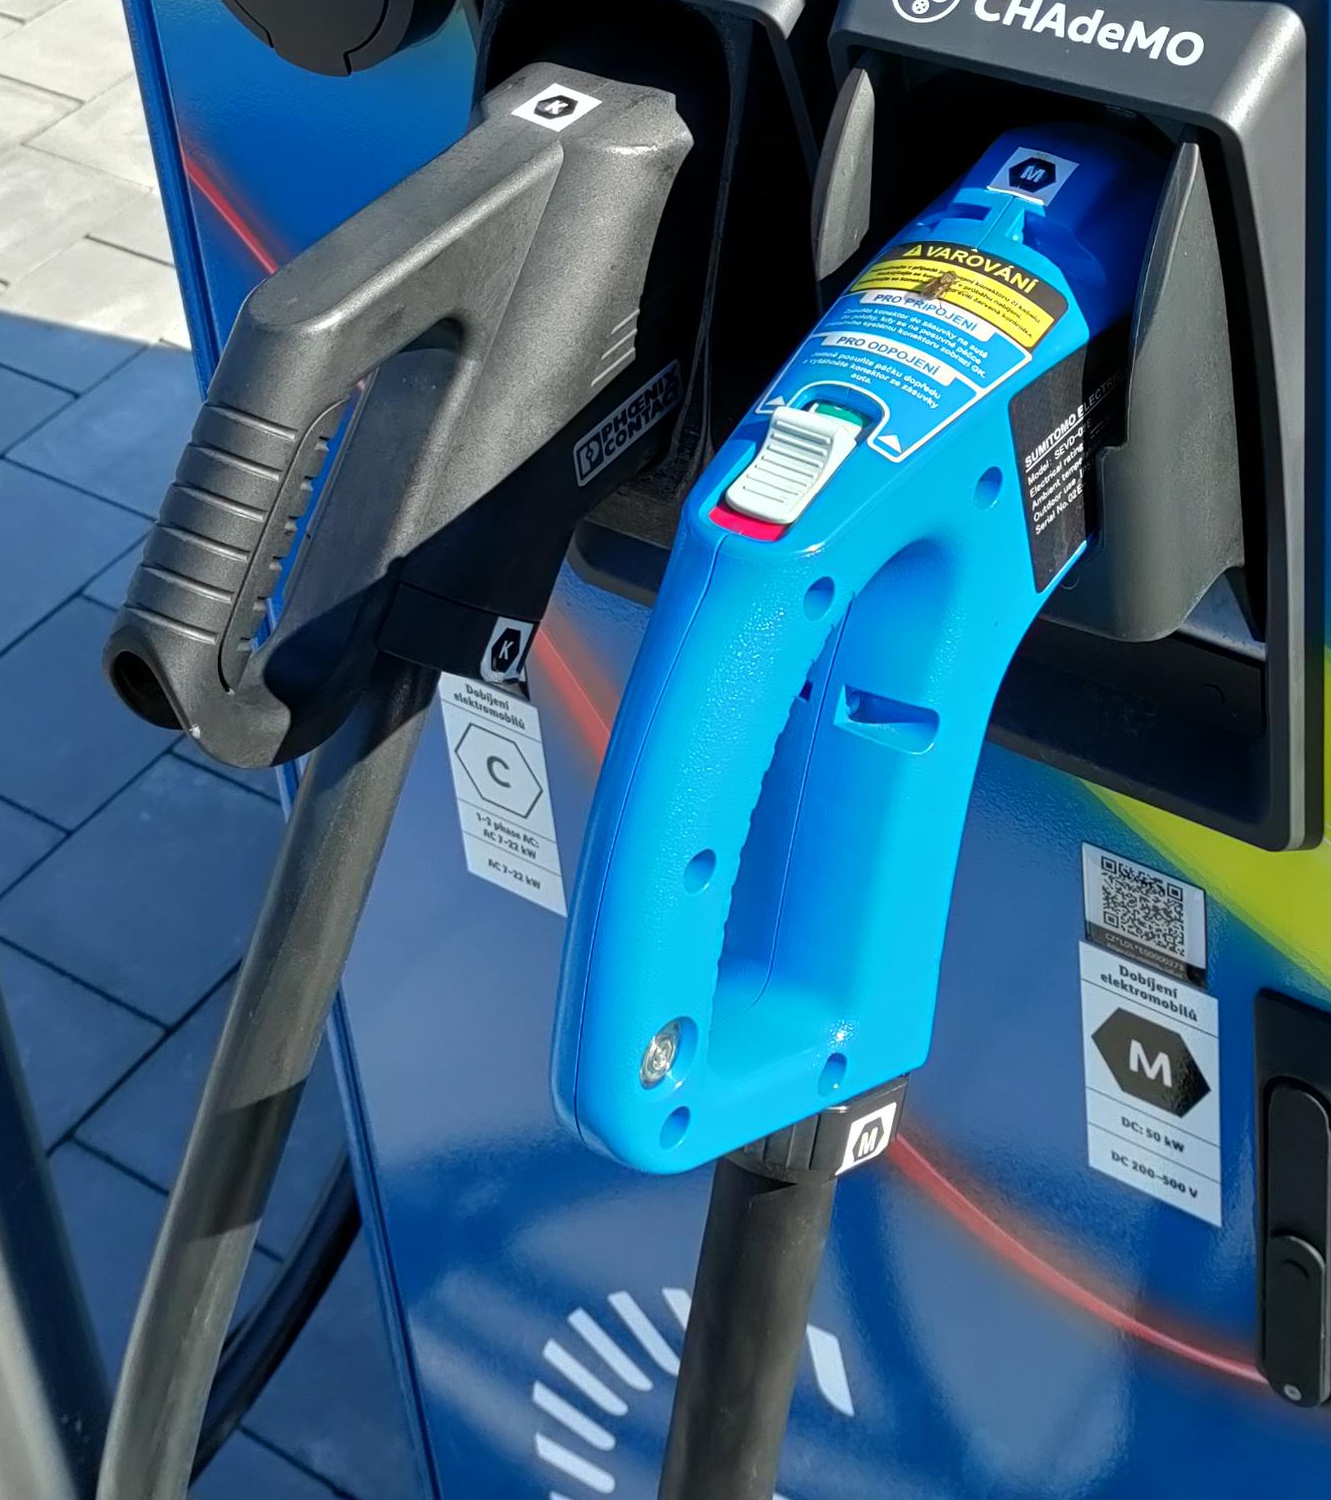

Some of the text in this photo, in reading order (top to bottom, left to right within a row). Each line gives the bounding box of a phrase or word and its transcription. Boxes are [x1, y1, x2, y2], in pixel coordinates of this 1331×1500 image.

[544, 100, 568, 115] K
[1019, 164, 1045, 183] M
[926, 245, 1039, 294] VAROVÁNÍ
[874, 294, 902, 304] PRO
[873, 308, 909, 320] konektor
[910, 316, 922, 324] do
[922, 320, 957, 340] zásuvky
[957, 338, 969, 347] na
[897, 328, 941, 349] konektoru
[907, 324, 920, 332] na
[836, 336, 941, 376] PRO ODPOJENÍ
[849, 362, 890, 381] konektor
[889, 378, 902, 387] ze
[901, 382, 939, 410] zásuvky
[1024, 413, 1077, 468] SUMITOMO
[1029, 460, 1063, 498] Electrical
[1031, 478, 1062, 511] Ambient
[1033, 478, 1077, 522] Outdoor use
[1035, 509, 1056, 535] Serial
[499, 640, 514, 661] K
[453, 692, 526, 731] elektromobilů
[465, 683, 509, 712] Dobíjení
[486, 754, 513, 789] C
[483, 828, 497, 842] AC
[520, 844, 537, 860] kW
[488, 858, 502, 872] AC
[525, 875, 541, 890] kW
[1100, 972, 1198, 1023] elektromobilů
[1118, 963, 1179, 1000] Dobíjení
[1128, 1038, 1173, 1088] M
[857, 1126, 879, 1158] M
[1121, 1115, 1185, 1153] DC: 50 kW
[1110, 1149, 1129, 1167] DC
[1188, 1186, 1198, 1199] V
